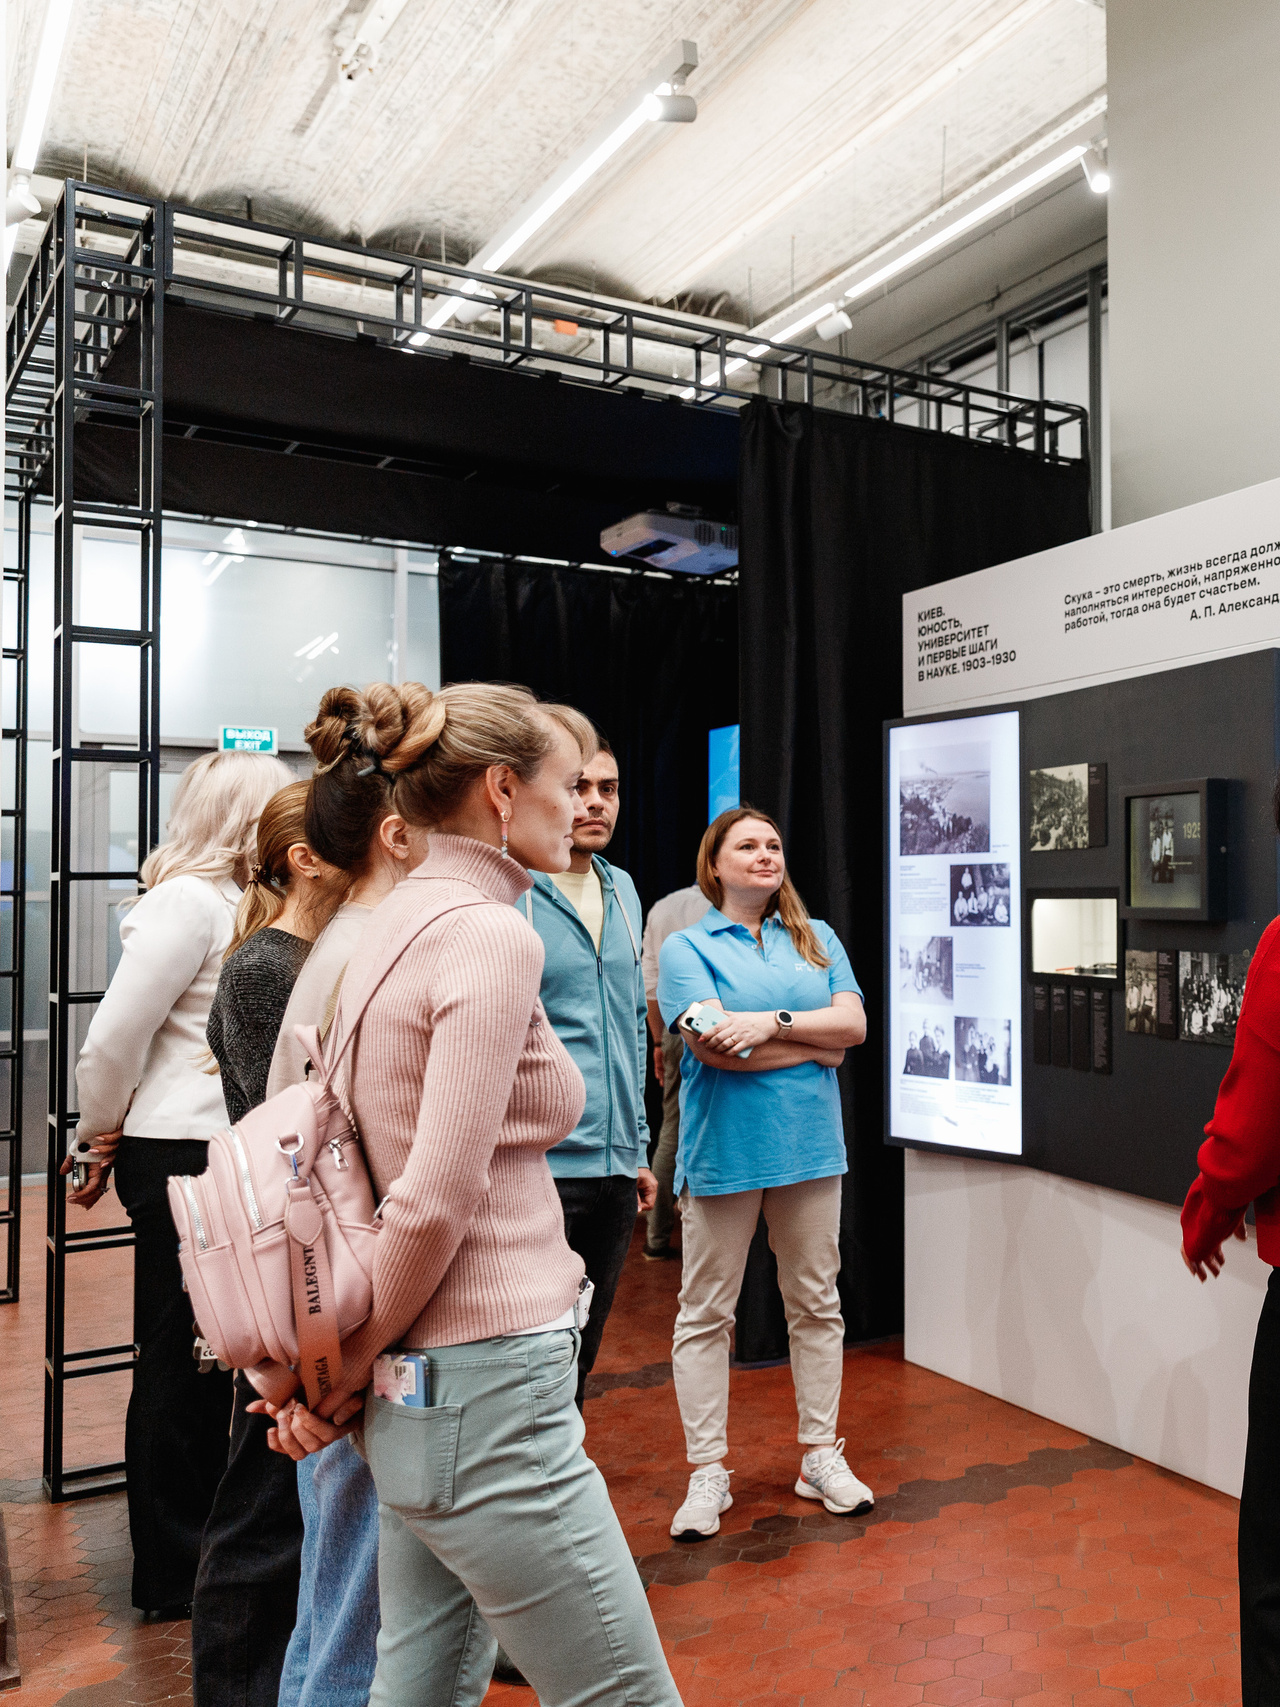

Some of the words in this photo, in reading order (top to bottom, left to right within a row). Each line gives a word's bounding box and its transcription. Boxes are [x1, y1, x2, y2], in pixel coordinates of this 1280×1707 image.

[1064, 590, 1093, 605] Скука
[1103, 583, 1120, 596] это
[1123, 570, 1164, 592] смерть,
[1167, 562, 1203, 579] жизнь
[1205, 548, 1247, 570] всегда
[1064, 596, 1129, 619] наполняться
[1131, 575, 1201, 602] интересной,
[1064, 611, 1108, 634] работой,
[1110, 605, 1139, 621] тогда
[1142, 599, 1161, 612] она
[1163, 590, 1196, 609] будет
[1199, 578, 1260, 599] счастьем.
[918, 606, 945, 623] КИЕВ.
[1190, 609, 1201, 621] А.
[1204, 605, 1216, 618] П.
[918, 618, 962, 637] ЮНОСТЬ,
[918, 625, 989, 652] УНИВЕРСИТЕТ
[918, 656, 924, 667] И
[927, 647, 966, 663] ПЕРВЫЕ
[968, 638, 998, 656] ШАГИ
[918, 670, 924, 681] В
[926, 663, 960, 679] НАУКЕ.
[226, 729, 270, 742] ВЫХОД
[235, 740, 262, 750] EXIT
